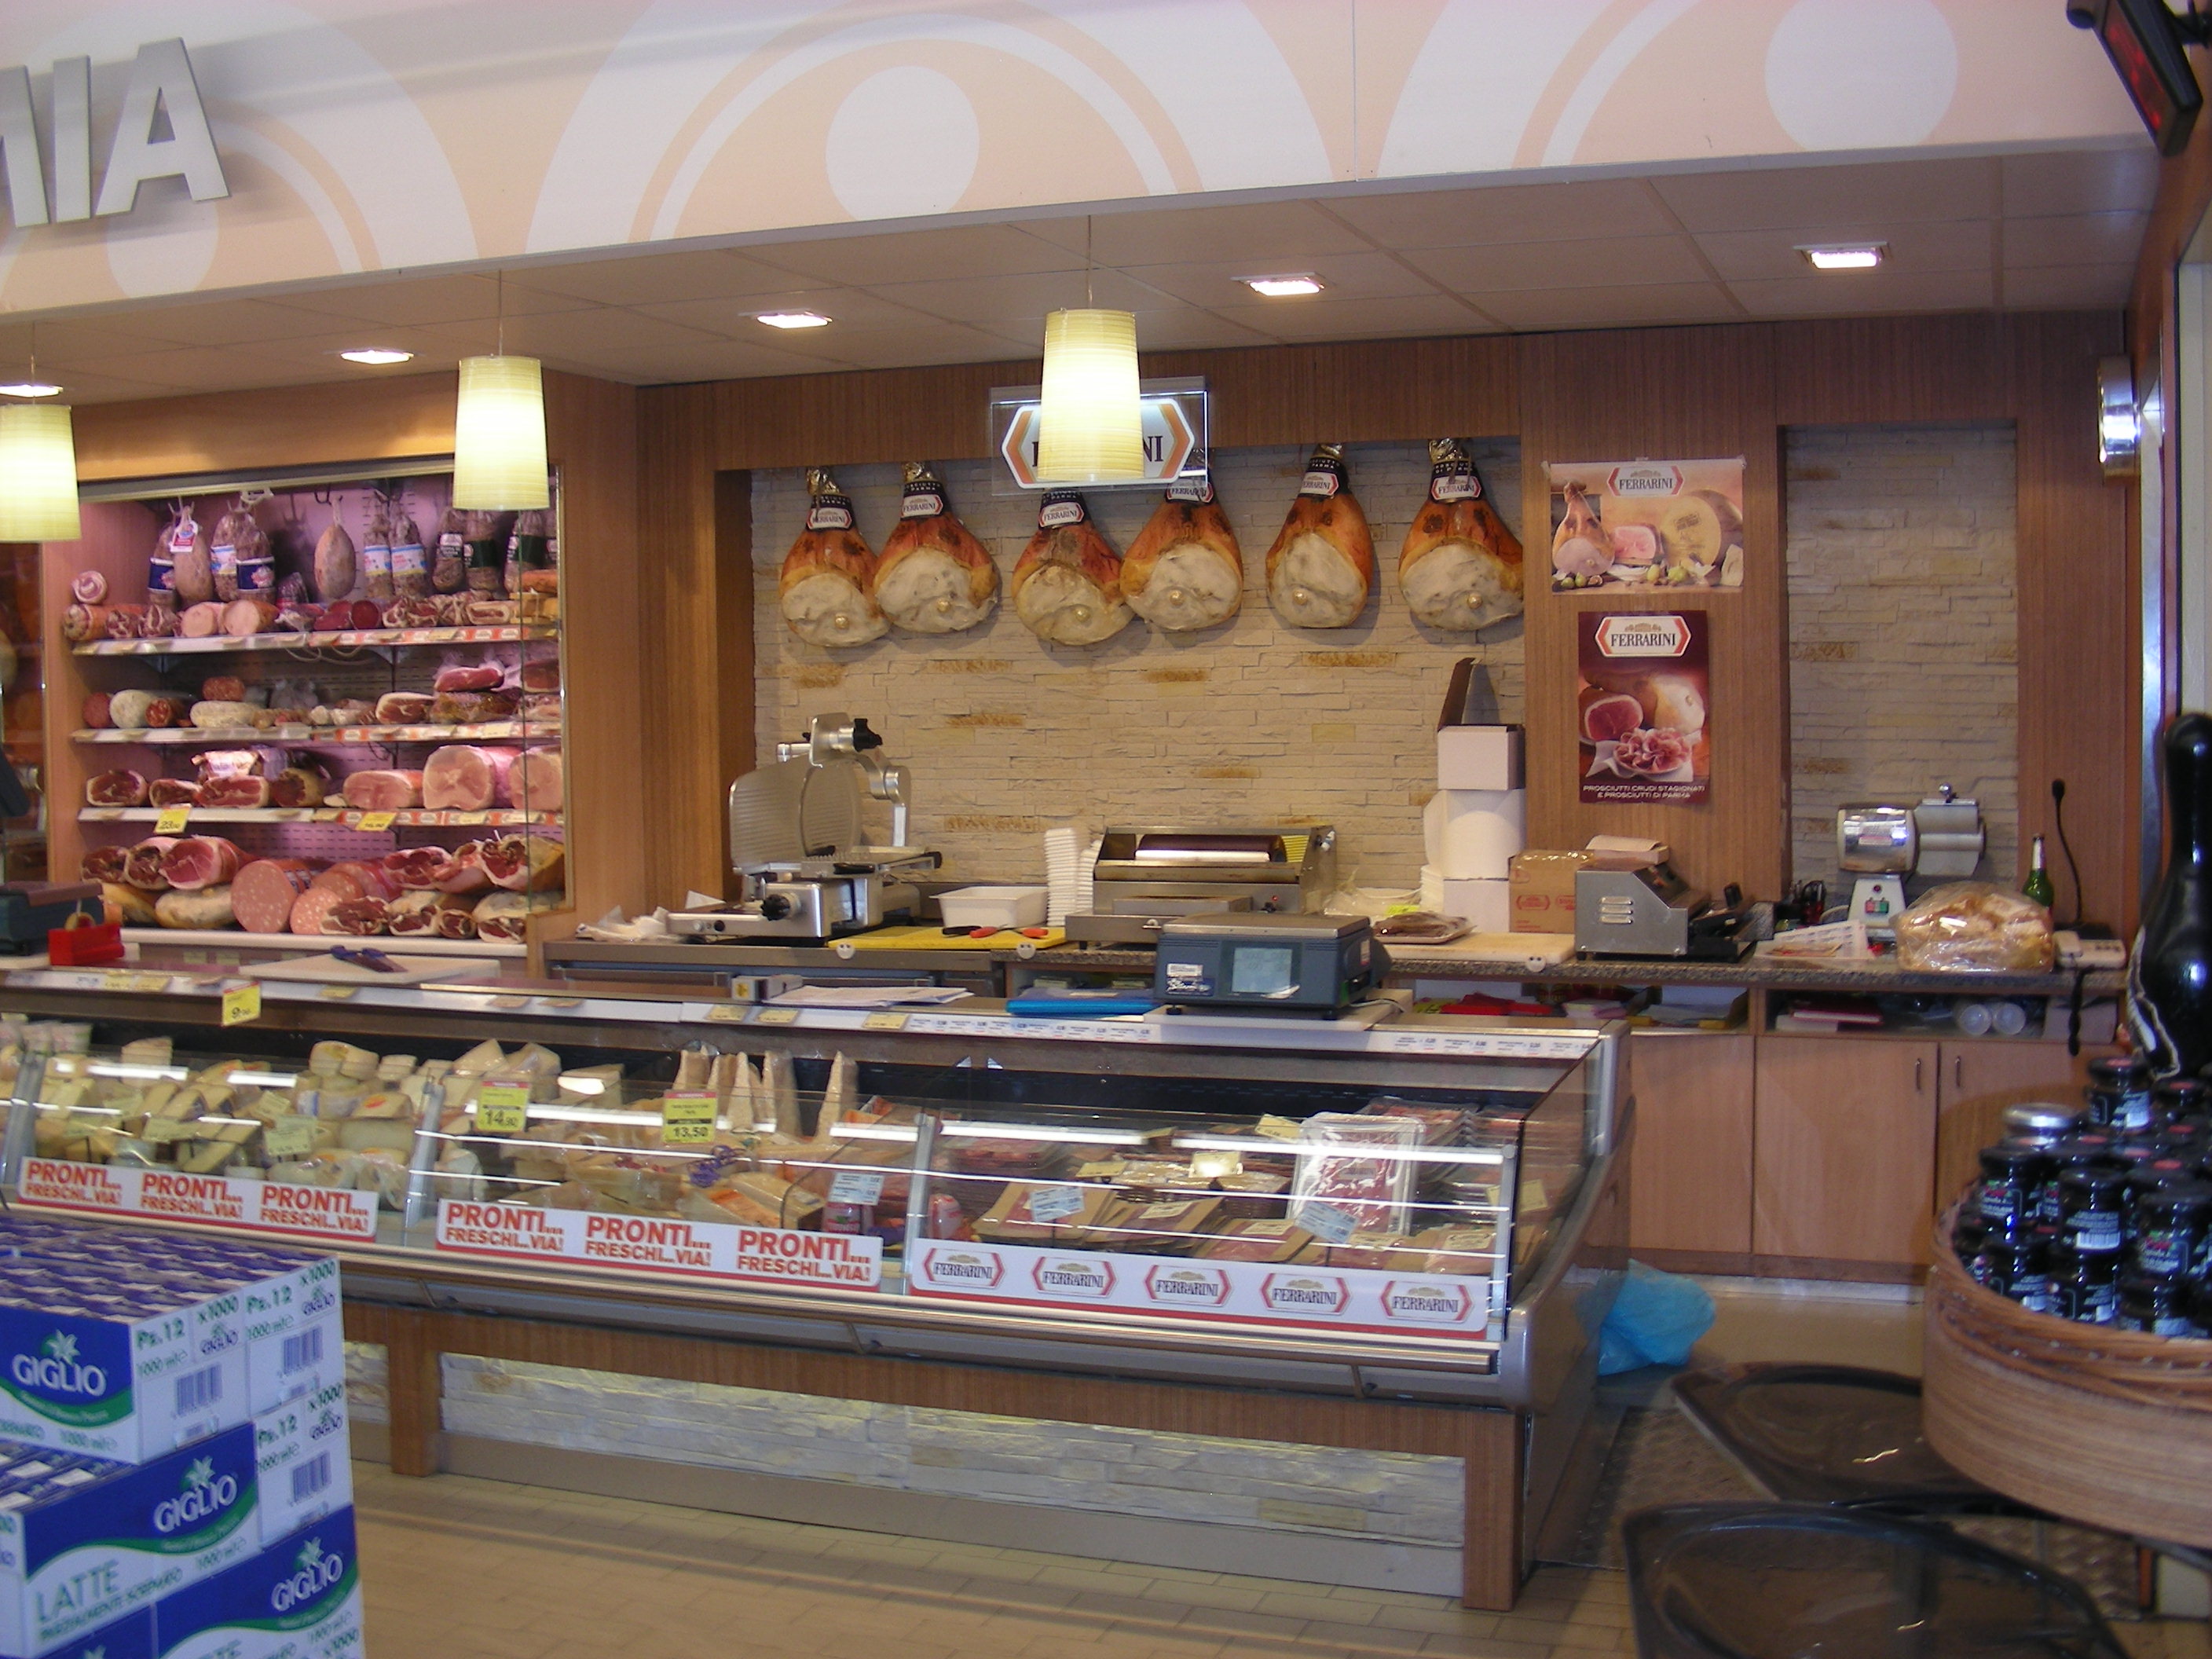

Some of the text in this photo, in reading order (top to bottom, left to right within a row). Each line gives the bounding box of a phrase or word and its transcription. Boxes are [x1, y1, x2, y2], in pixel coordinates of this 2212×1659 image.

[1619, 478, 1673, 490] FERRARINI
[1044, 510, 1077, 522] FERRARINI
[1611, 633, 1676, 647] FERRARINI
[933, 1262, 993, 1279] FERRARINI
[1042, 1271, 1104, 1287] FERRARINI
[1155, 1280, 1219, 1296] FERRARINI
[1271, 1287, 1338, 1305] FERRARINI
[1392, 1296, 1459, 1313] FERRARINI
[12, 1353, 107, 1397] GIGLIO
[154, 1474, 237, 1533] GIGLIO
[271, 1552, 343, 1611] GIGLIO
[36, 1558, 120, 1624] LATTE
